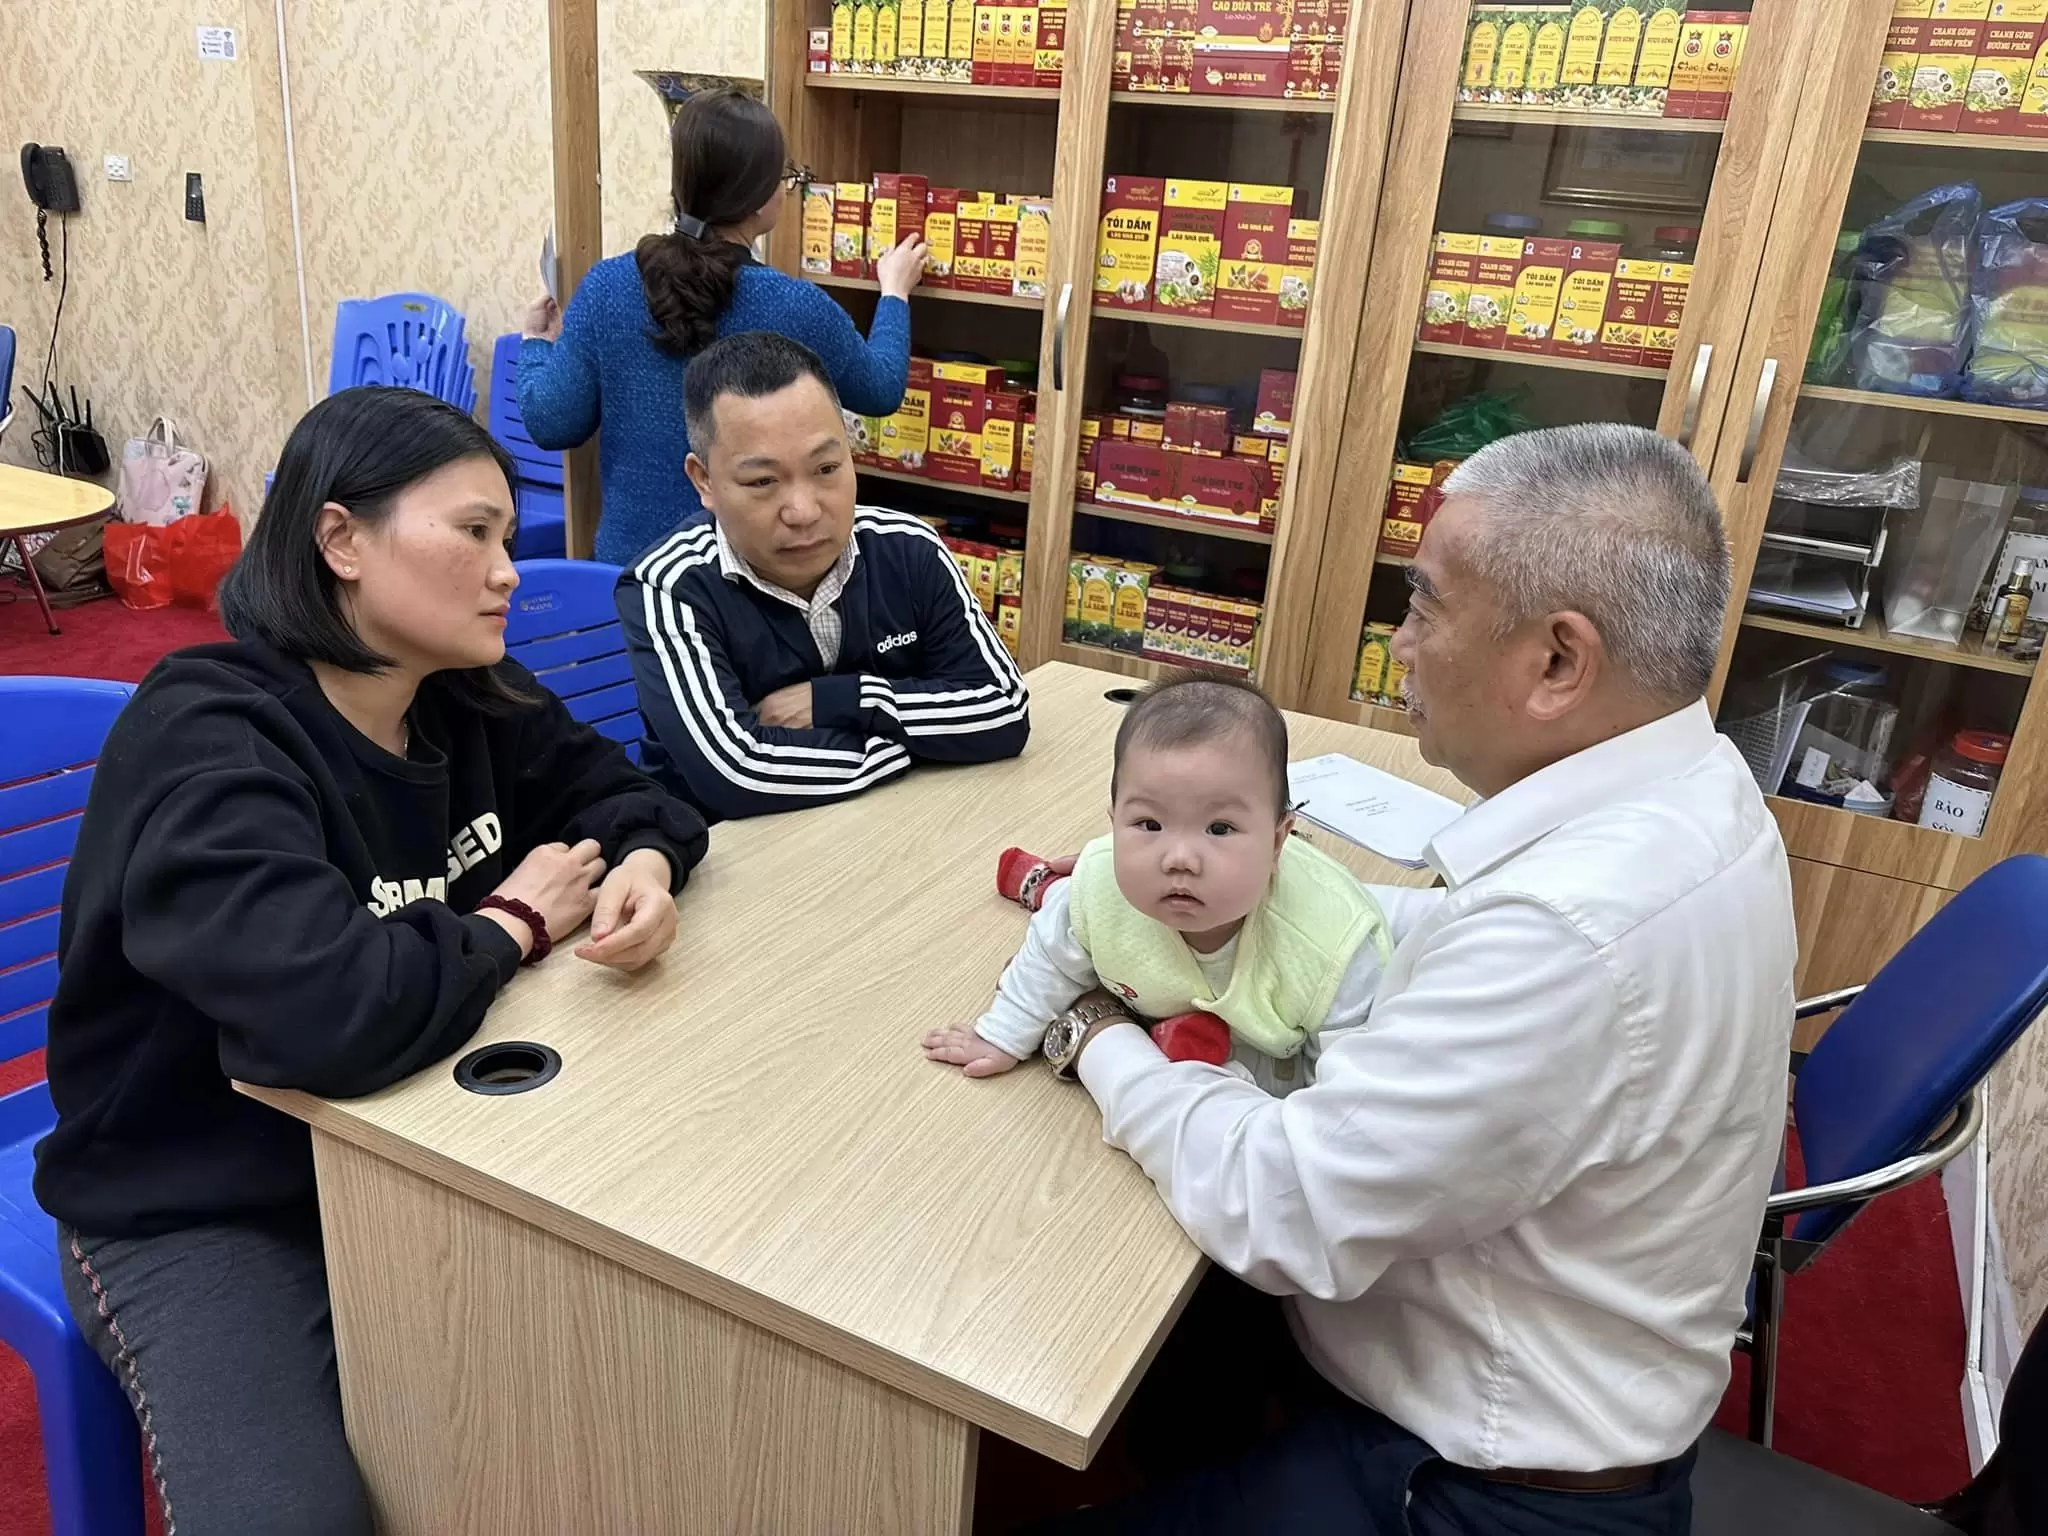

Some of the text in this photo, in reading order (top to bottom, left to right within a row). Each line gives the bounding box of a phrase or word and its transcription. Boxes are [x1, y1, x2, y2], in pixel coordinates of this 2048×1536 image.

[1932, 27, 1956, 36] CHANH
[1990, 30, 2014, 39] CHANH
[1127, 215, 1151, 231] DẤM
[877, 631, 918, 653] adidas
[1935, 799, 1964, 818] BẢO
